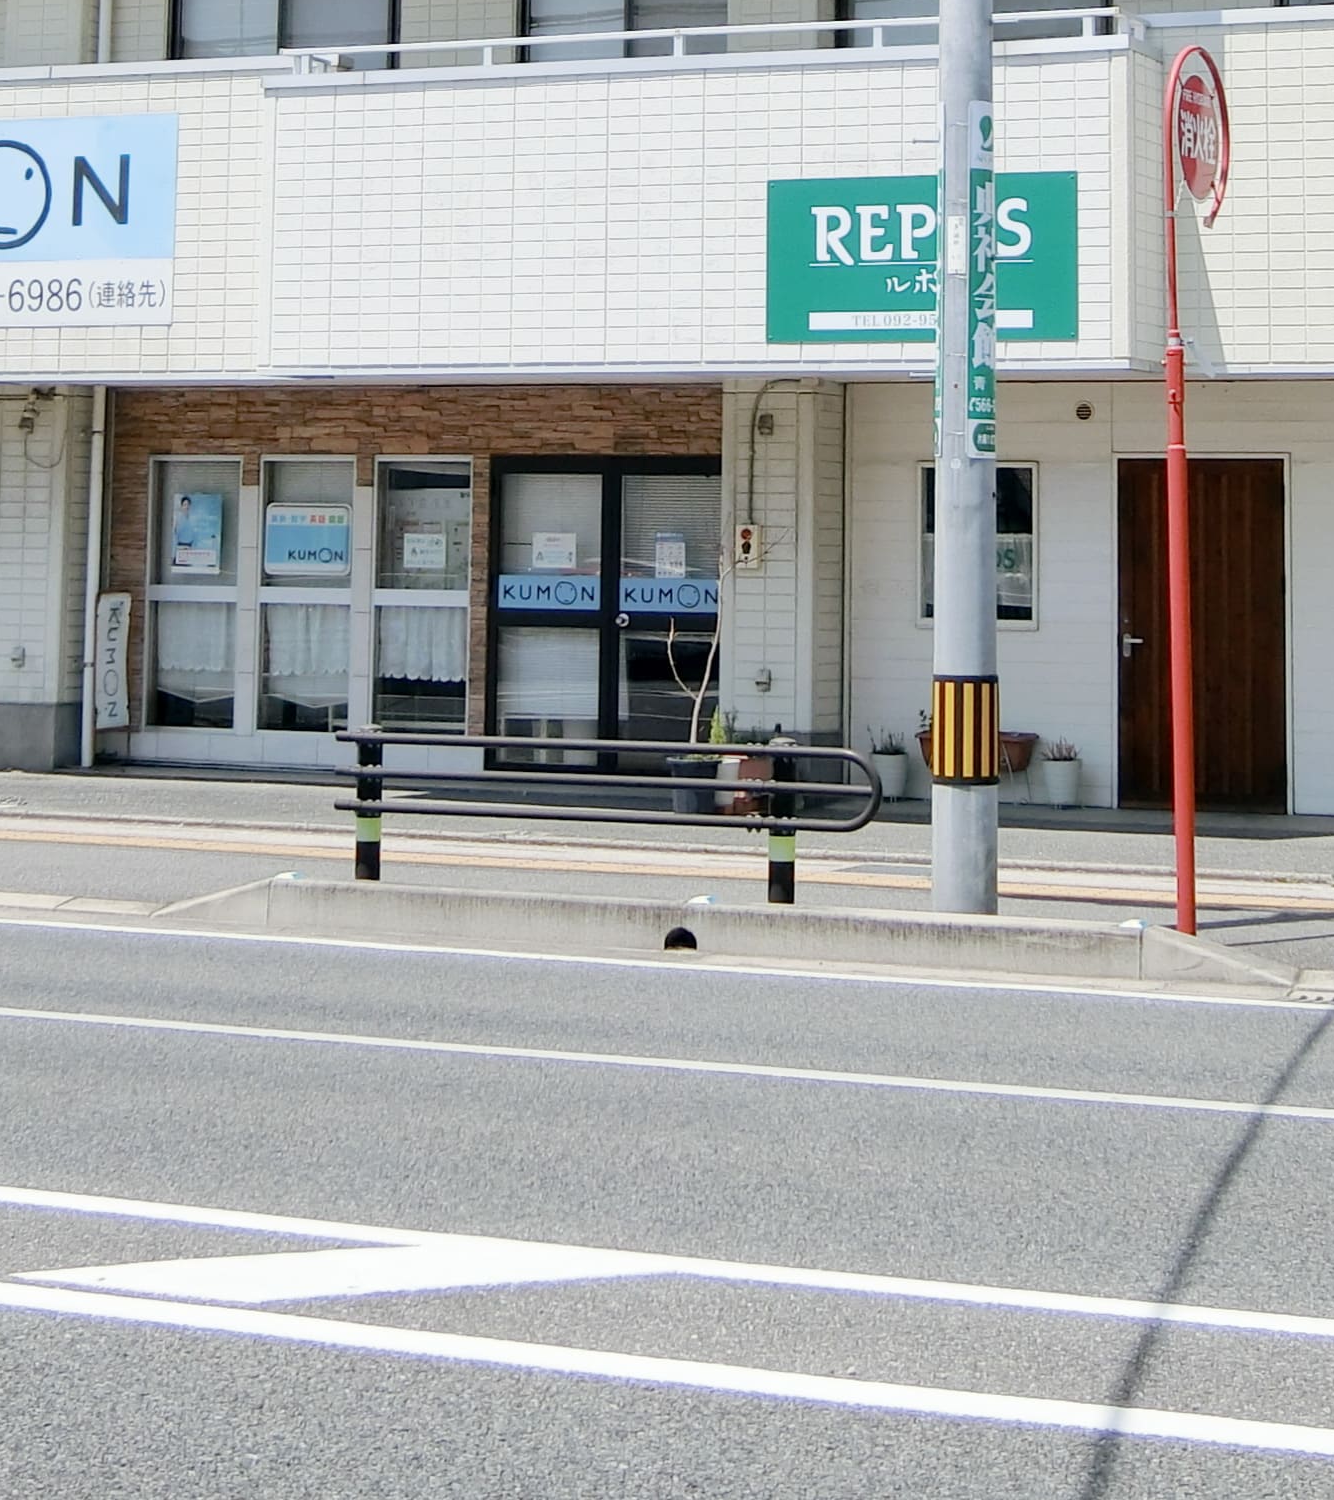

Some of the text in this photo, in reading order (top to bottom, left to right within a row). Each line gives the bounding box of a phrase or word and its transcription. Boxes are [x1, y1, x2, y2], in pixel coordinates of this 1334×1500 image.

[1180, 109, 1216, 165] 消火栓
[809, 196, 1033, 267] REPS
[885, 268, 937, 294] ルポ
[287, 547, 344, 564] KUMON
[502, 580, 595, 605] KUMON
[624, 583, 718, 609] KUMON
[103, 607, 121, 718] KUMON
